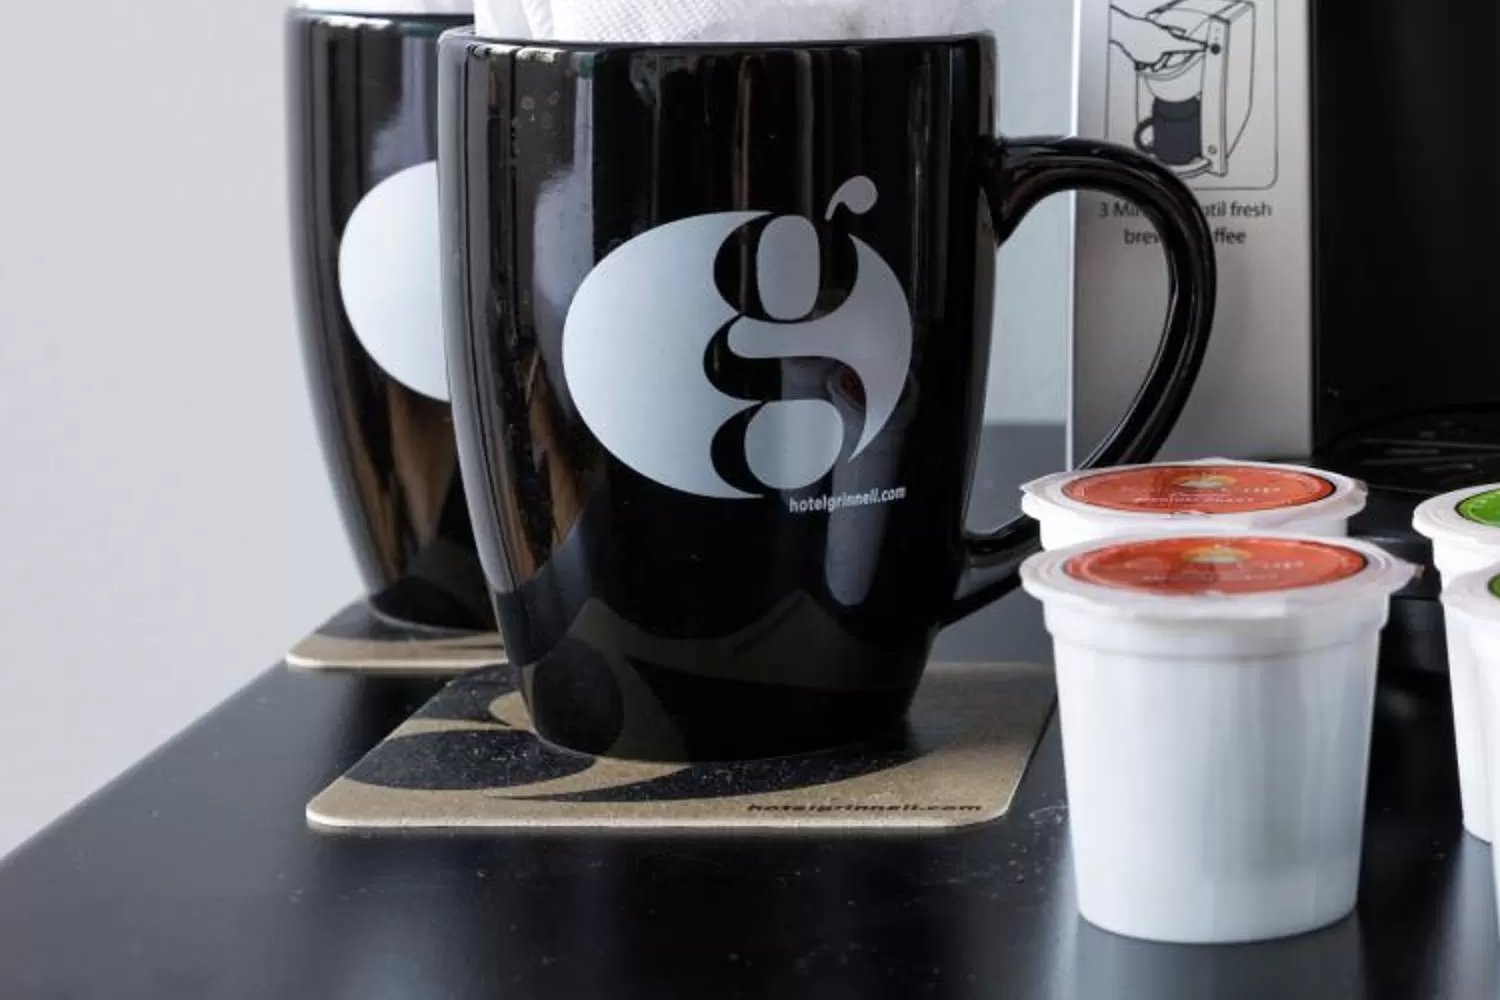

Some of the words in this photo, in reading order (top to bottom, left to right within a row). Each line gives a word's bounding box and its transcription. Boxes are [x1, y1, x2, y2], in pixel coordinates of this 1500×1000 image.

[1098, 201, 1109, 219] 3
[1230, 200, 1273, 217] fresh
[788, 485, 907, 514] hotelgrinnell.com
